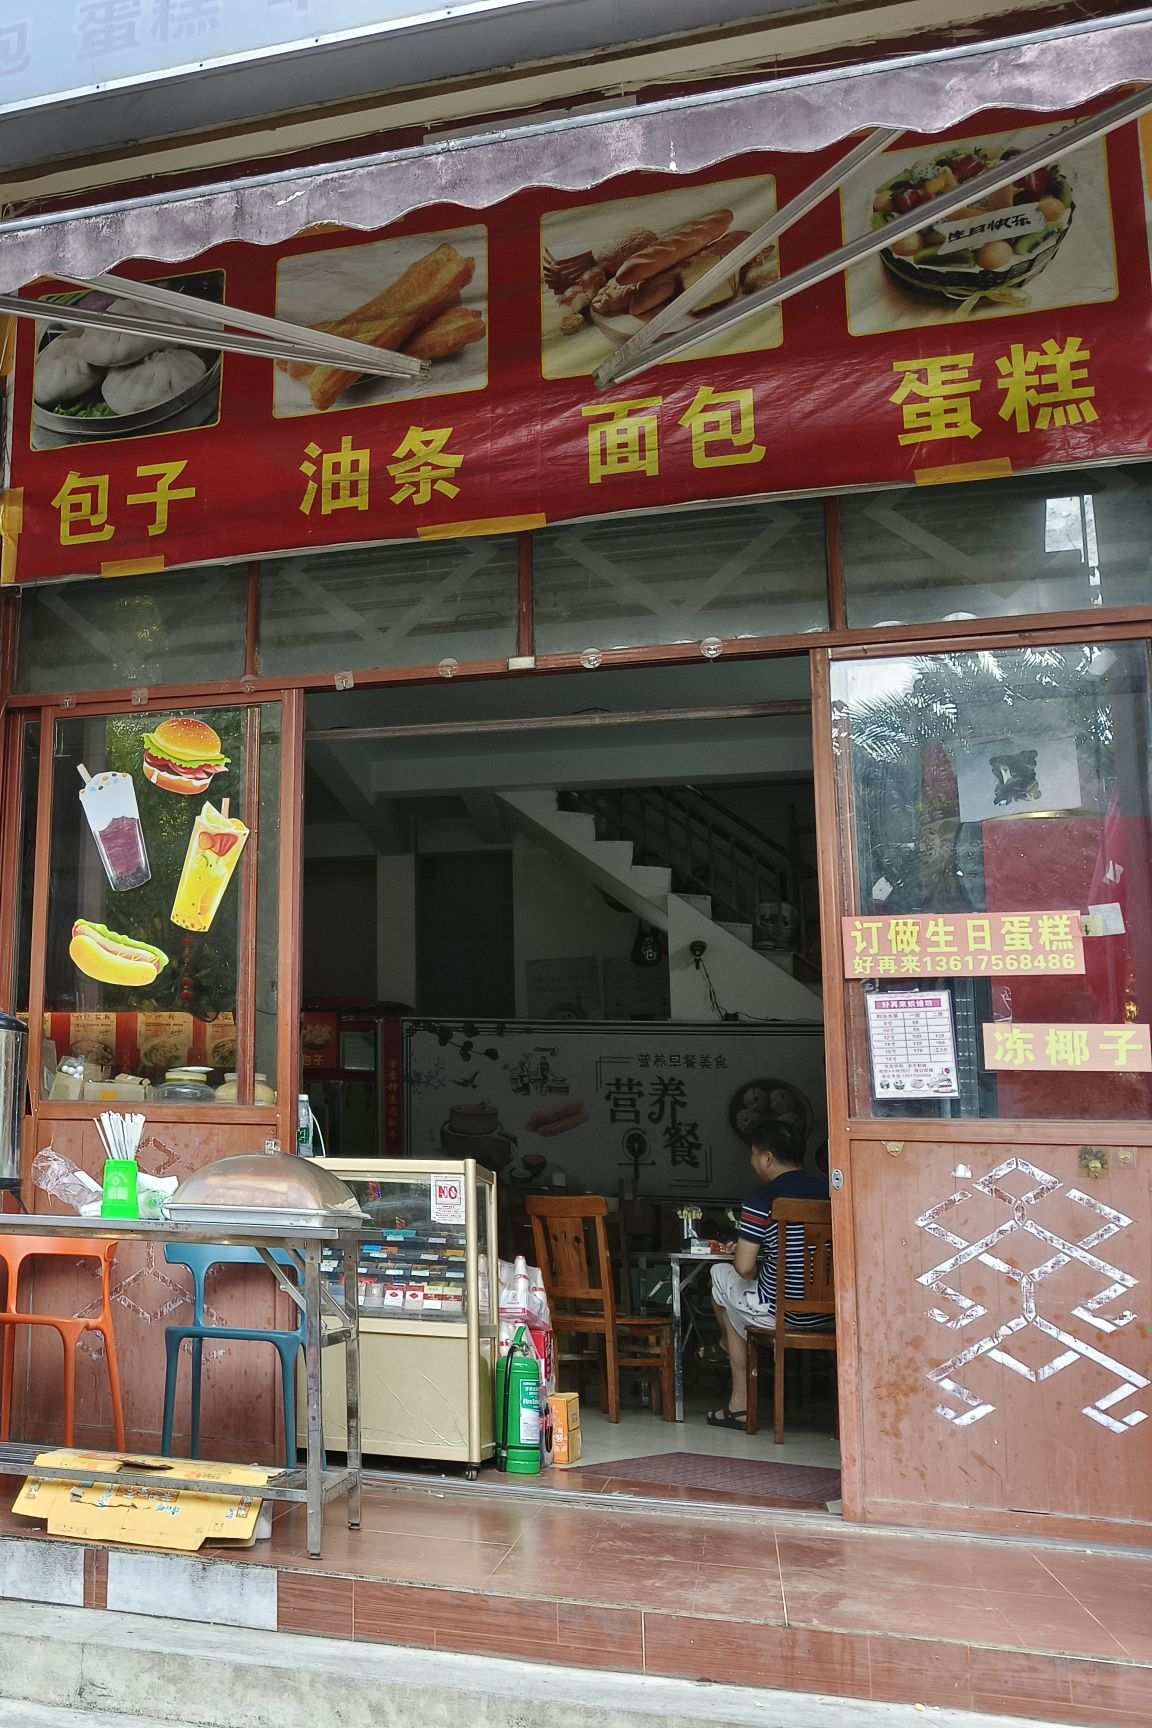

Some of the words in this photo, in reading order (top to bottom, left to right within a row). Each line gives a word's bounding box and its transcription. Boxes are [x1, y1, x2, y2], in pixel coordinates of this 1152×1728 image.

[50, 459, 196, 546] 包子
[298, 425, 465, 516] 油条
[579, 385, 767, 485] 面包
[889, 336, 1101, 447] 蛋糕
[850, 914, 1074, 954] 订做生日蛋糕
[993, 1027, 1144, 1067] 冻椰子
[604, 1075, 688, 1128] 营养
